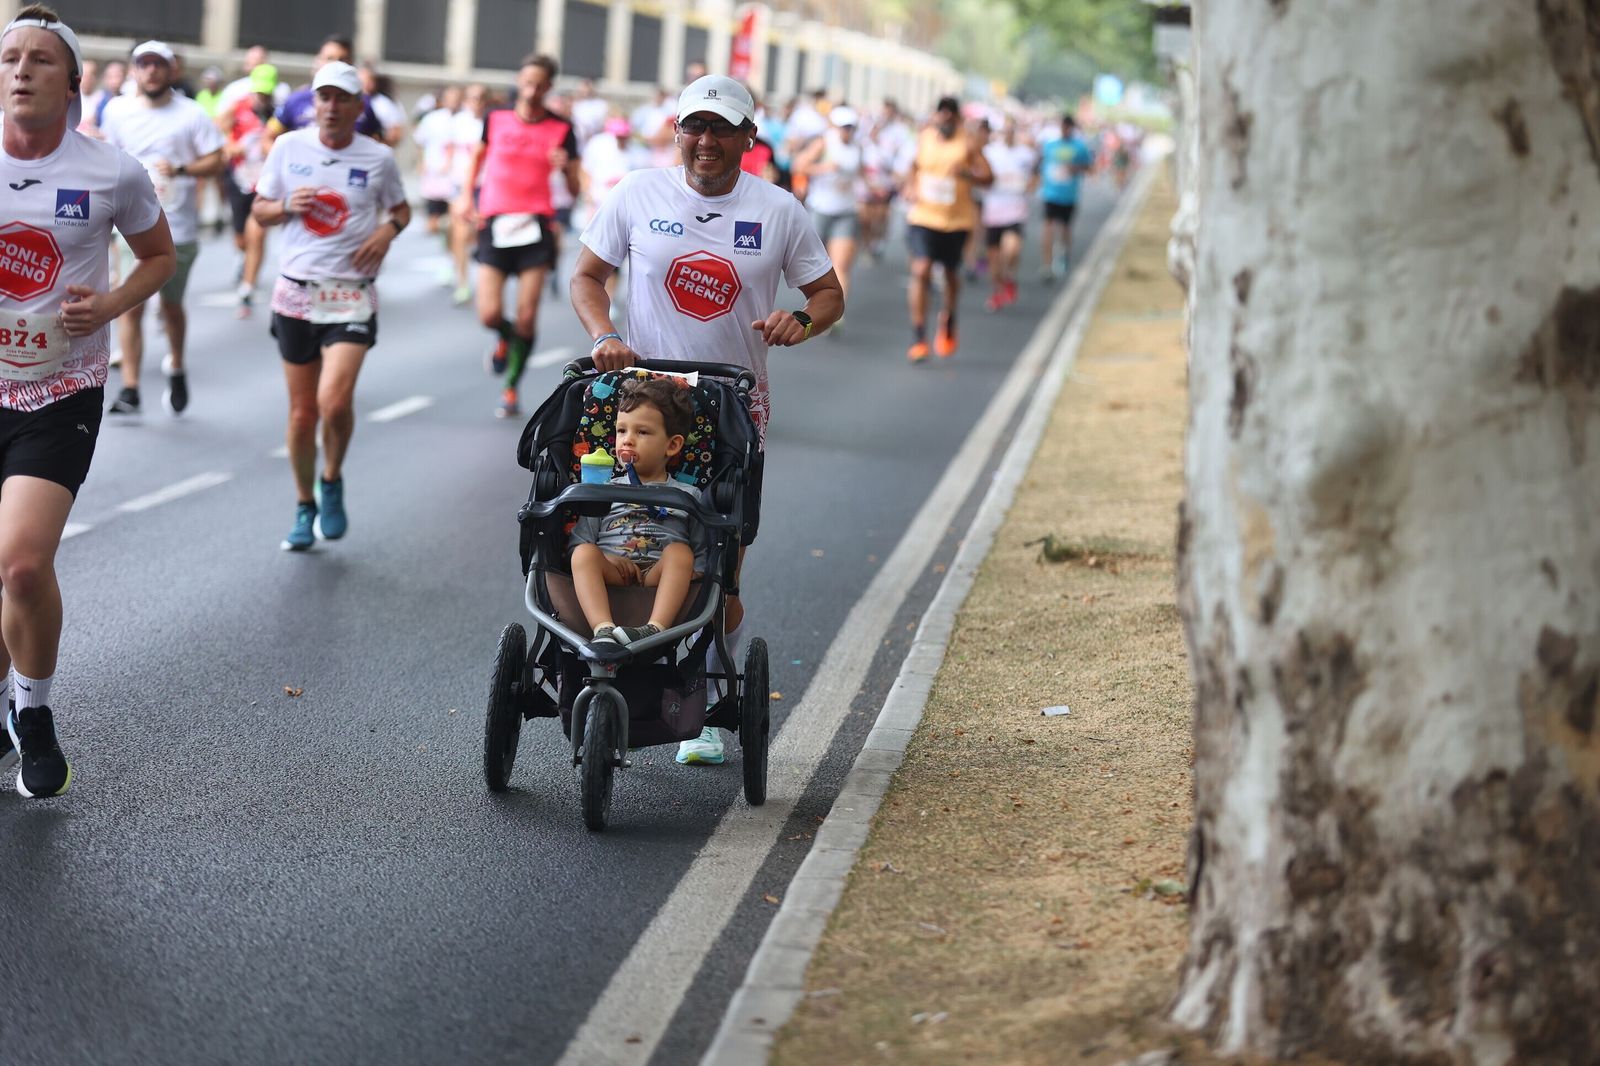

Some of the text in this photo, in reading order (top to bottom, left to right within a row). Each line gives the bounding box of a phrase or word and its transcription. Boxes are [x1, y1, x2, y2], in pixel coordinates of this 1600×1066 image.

[56, 203, 84, 217] AXA
[55, 219, 89, 228] fundación
[734, 235, 757, 247] AXA
[0, 254, 46, 283] RENO
[675, 277, 726, 305] FRENO
[680, 265, 732, 295] PONLE
[0, 327, 47, 349] 874
